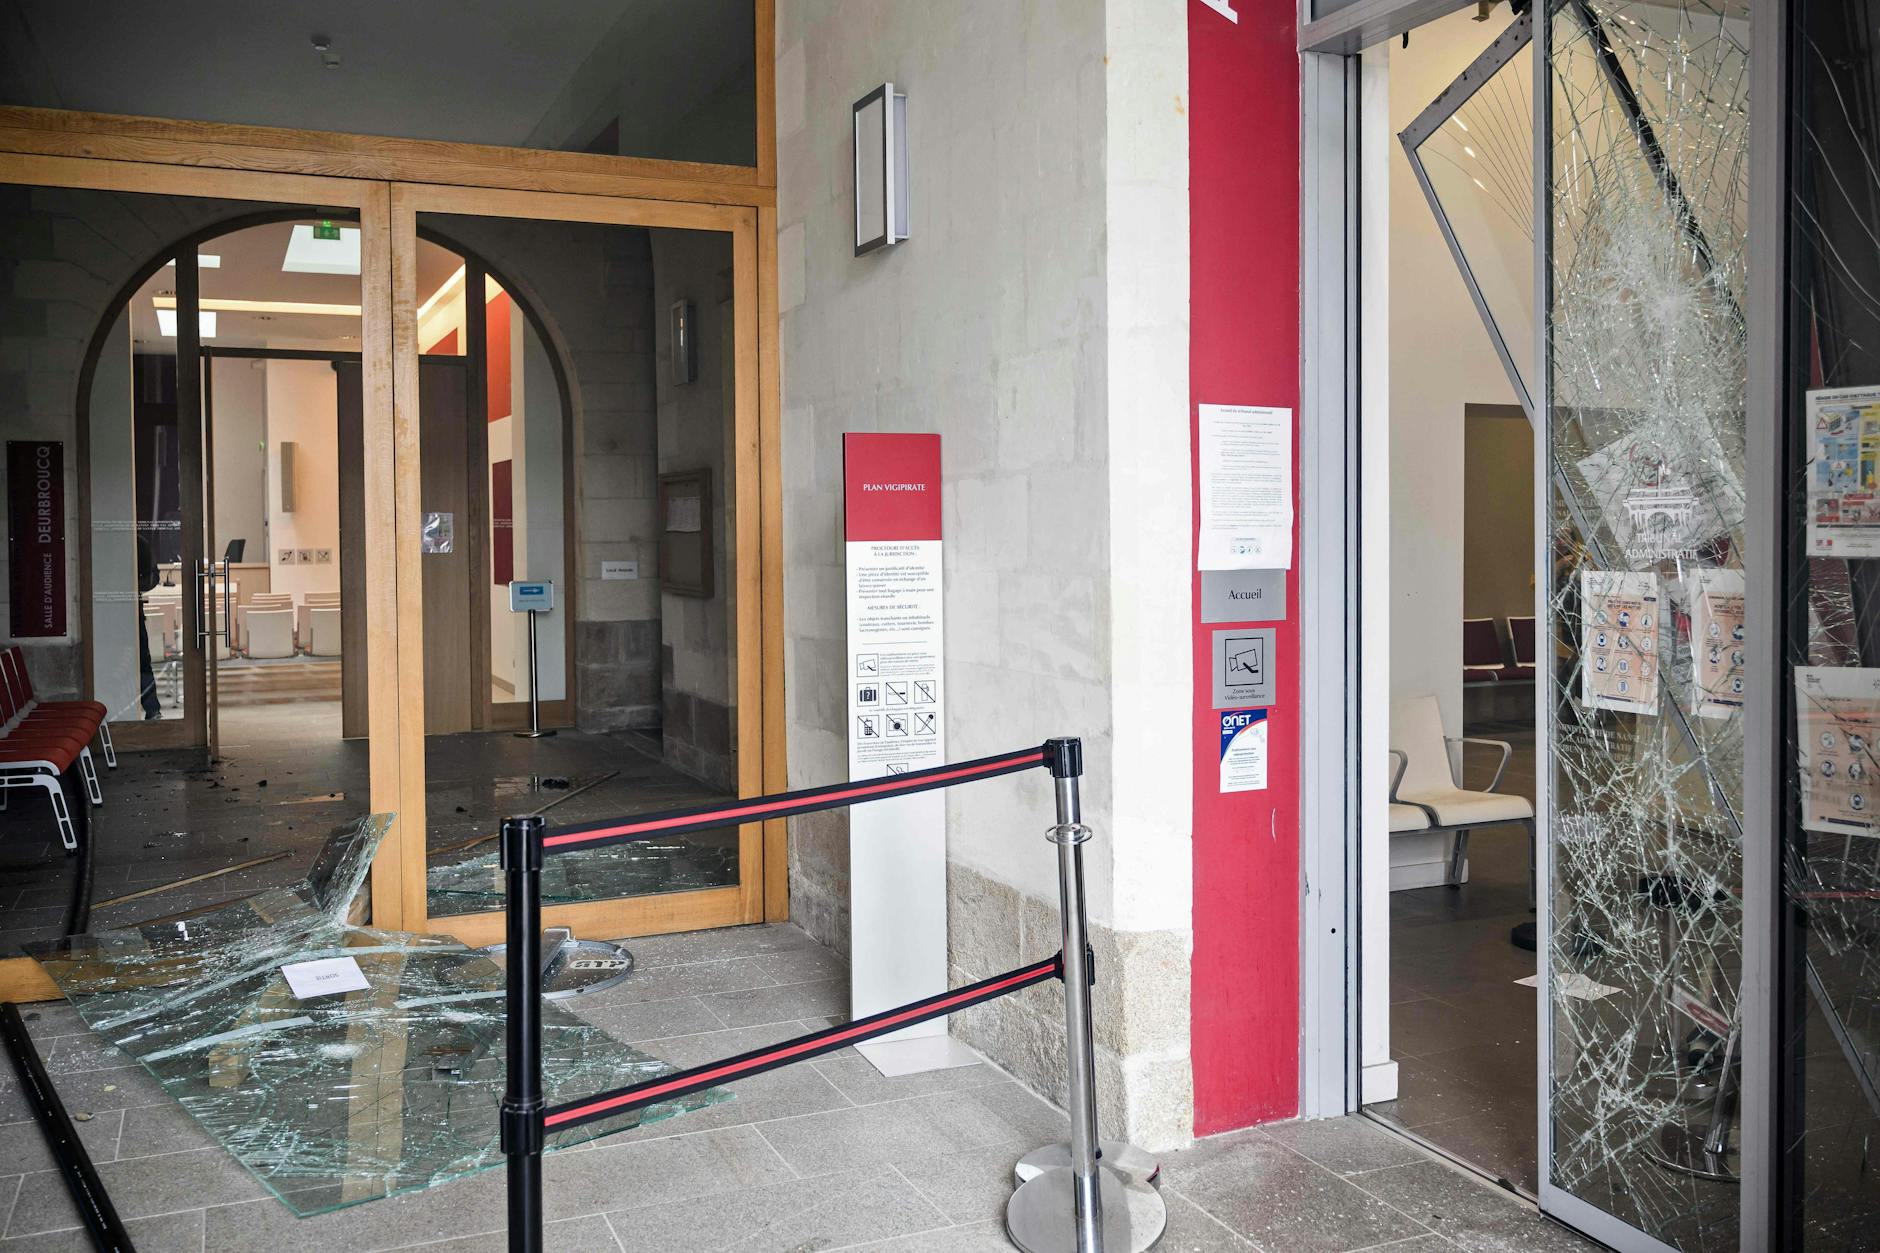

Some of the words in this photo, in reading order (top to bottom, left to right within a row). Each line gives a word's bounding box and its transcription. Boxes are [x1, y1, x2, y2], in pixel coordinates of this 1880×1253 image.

[37, 446, 51, 544] DEURBROUCQ
[863, 483, 883, 491] PLAN
[884, 483, 926, 491] VIGIPIRATE
[1625, 549, 1698, 560] ADMINISTRATIF
[43, 553, 53, 605] D'AUDIENCE
[1229, 588, 1262, 600] Accueil
[44, 609, 53, 629] SALLE
